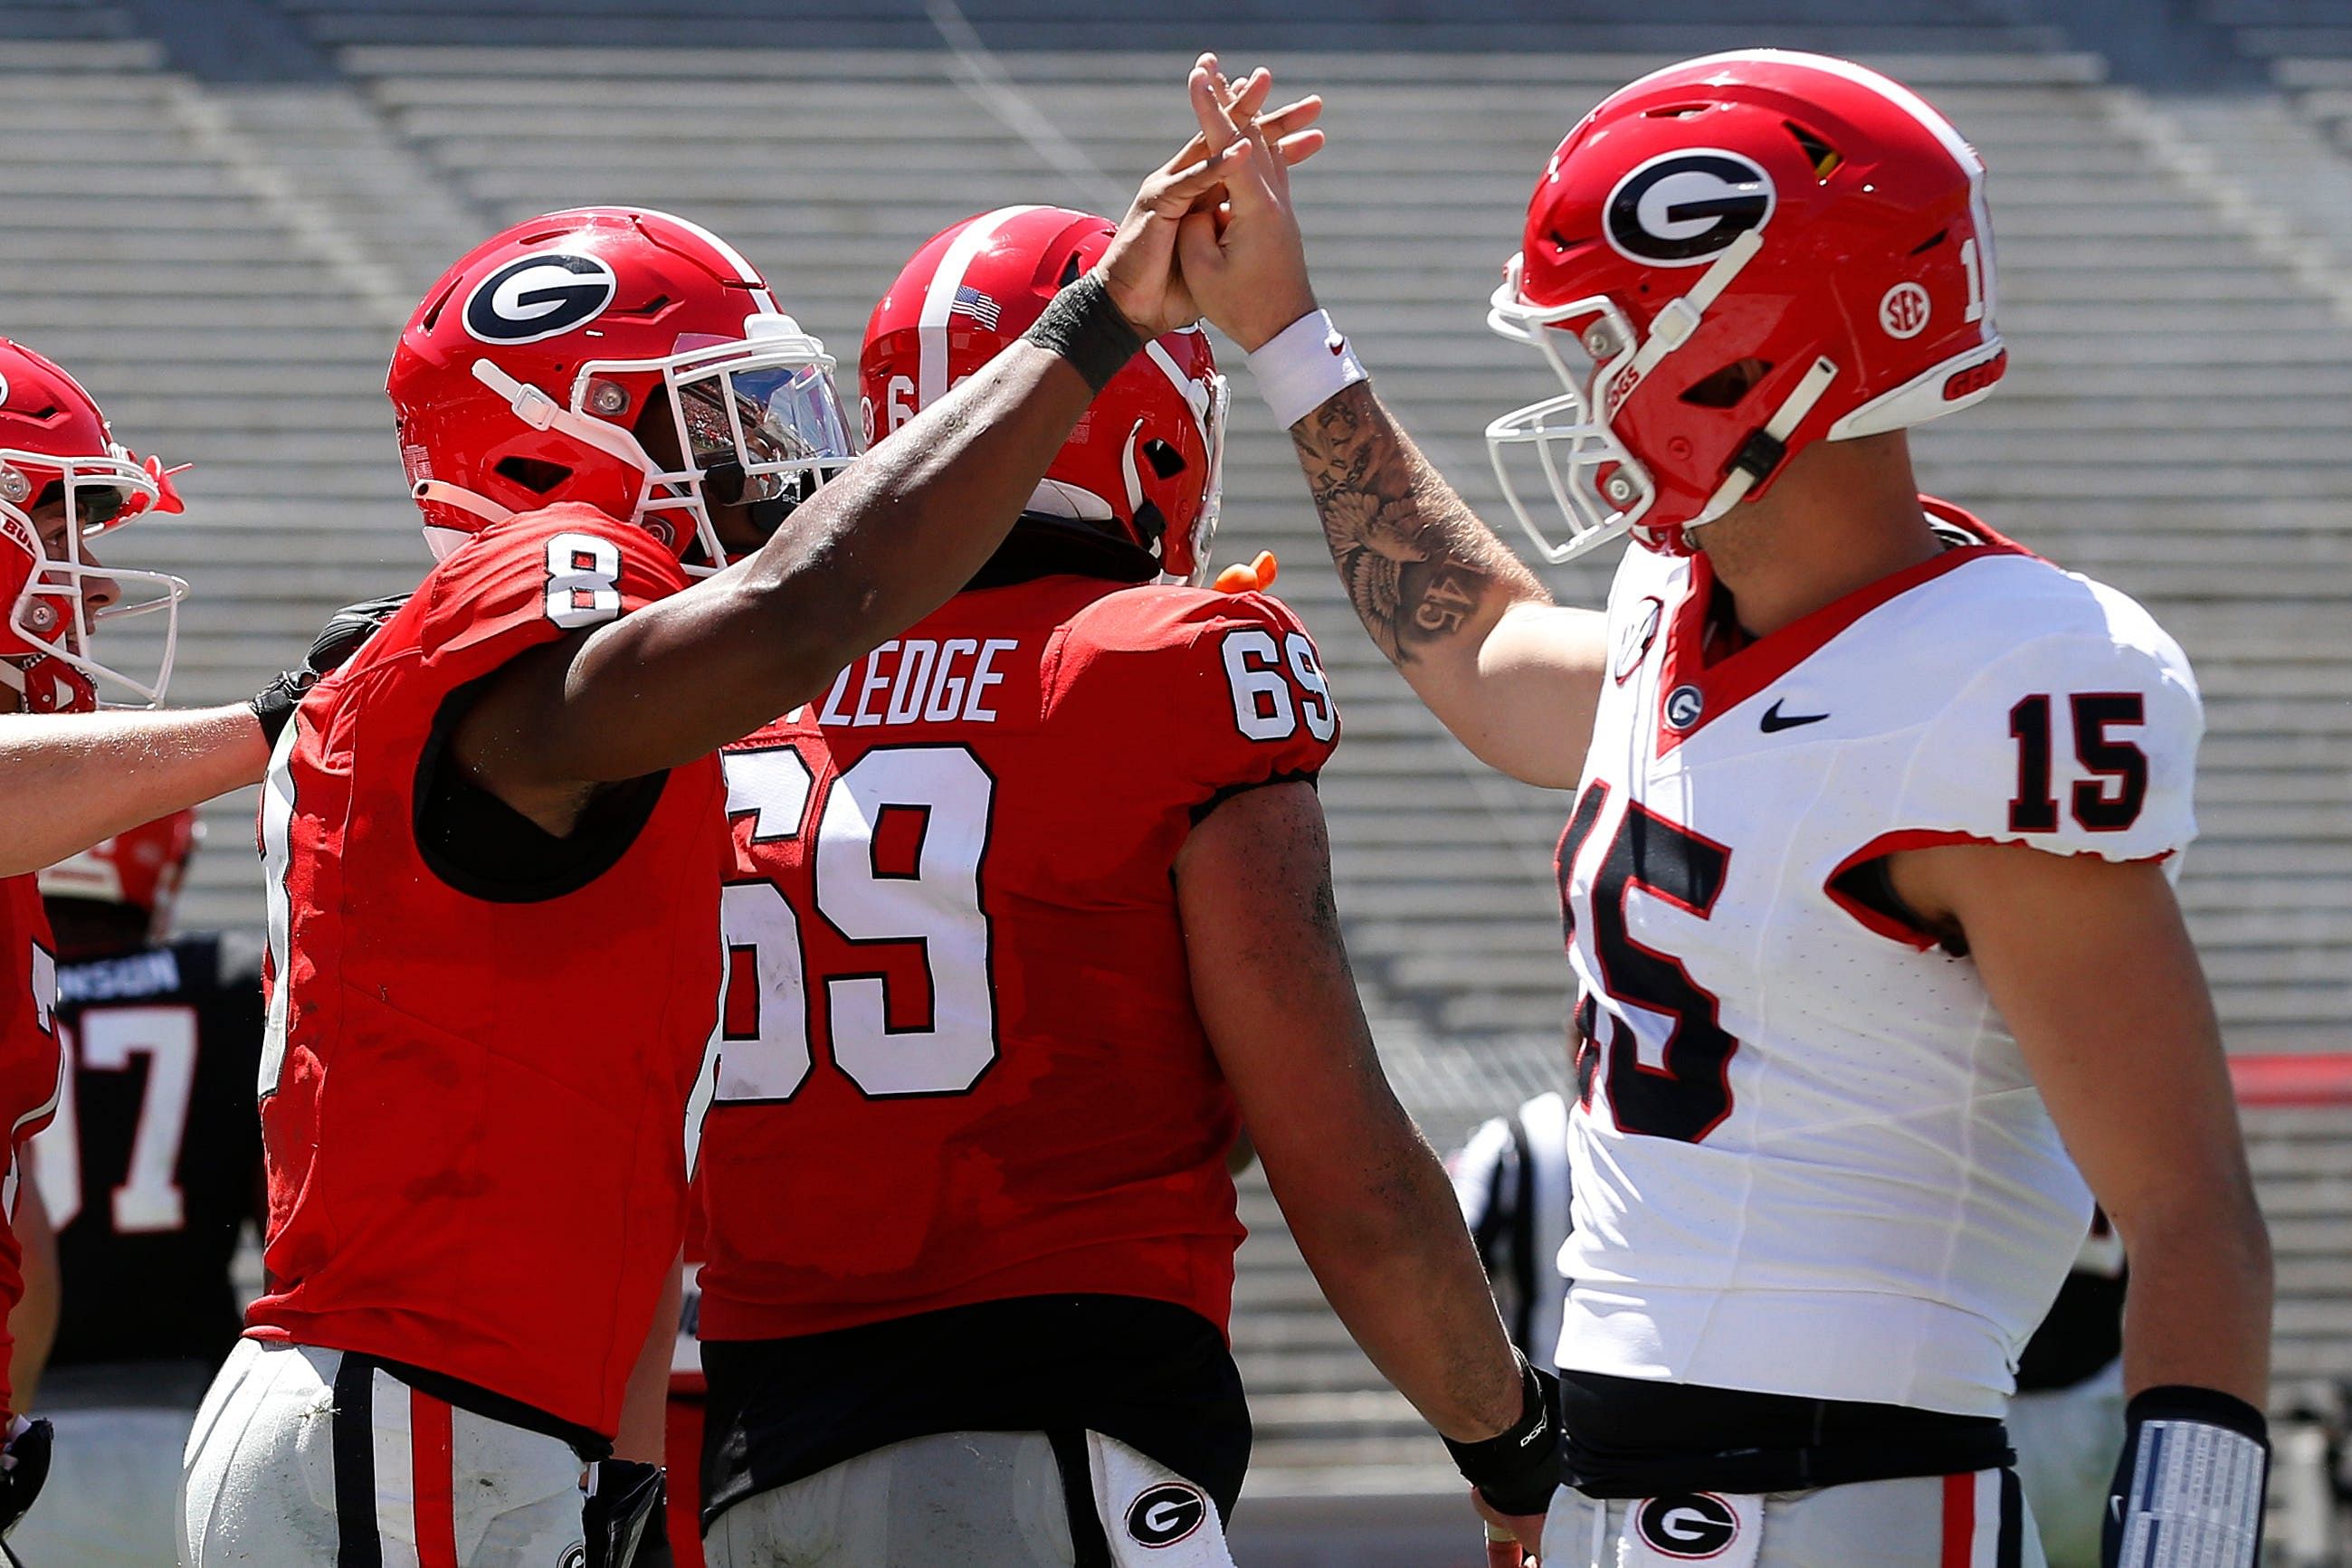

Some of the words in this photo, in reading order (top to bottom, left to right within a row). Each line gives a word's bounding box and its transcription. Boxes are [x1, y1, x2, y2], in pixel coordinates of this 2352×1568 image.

[1605, 149, 1774, 265] G
[465, 252, 614, 342] G
[1885, 287, 1928, 335] SEC
[545, 532, 622, 629] 8
[786, 639, 1019, 727] LEDGE
[1220, 630, 1338, 743] 69
[2007, 692, 2149, 834] 15
[718, 742, 997, 1100] 69
[1556, 777, 1740, 1145] 15
[1125, 1481, 1207, 1548] G
[1634, 1489, 1740, 1560] G
